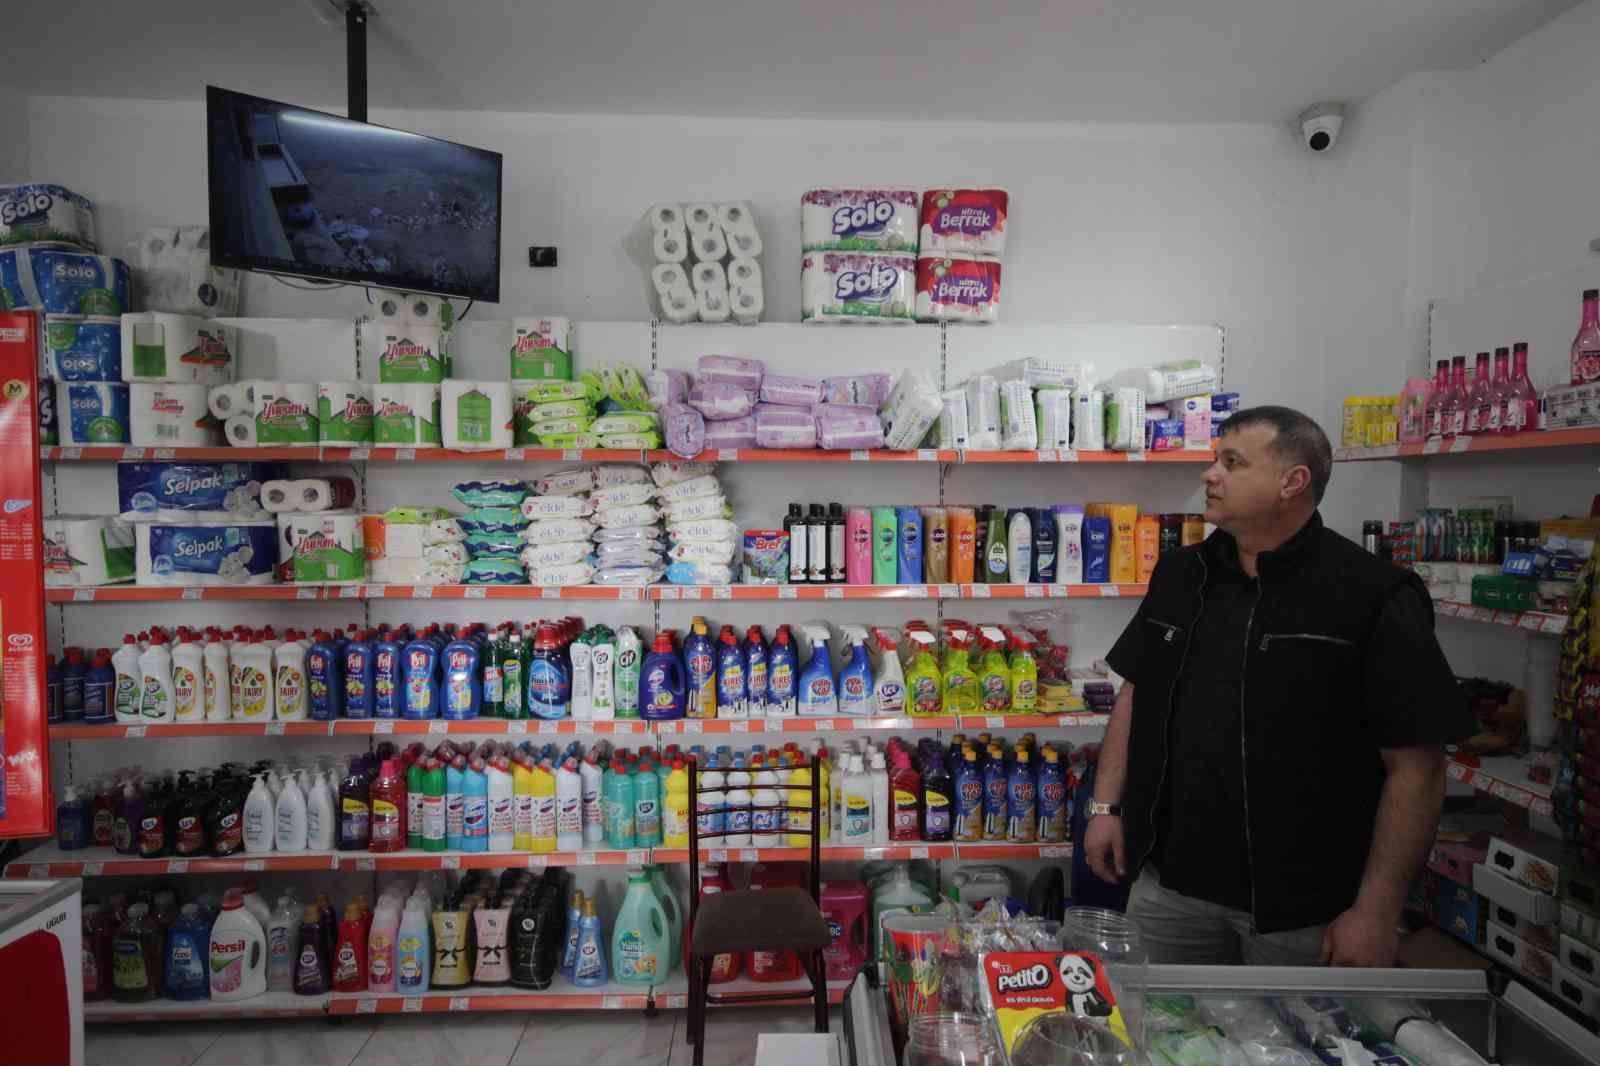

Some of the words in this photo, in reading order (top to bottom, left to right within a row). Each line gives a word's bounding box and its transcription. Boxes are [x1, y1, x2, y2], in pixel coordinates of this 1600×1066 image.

[940, 210, 990, 228] Berrak
[938, 281, 988, 299] Berrak
[164, 472, 224, 495] Selpak
[174, 535, 224, 557] Selpak
[244, 687, 263, 697] FAIRY
[280, 687, 299, 697] FAIRY
[211, 939, 245, 953] Persil
